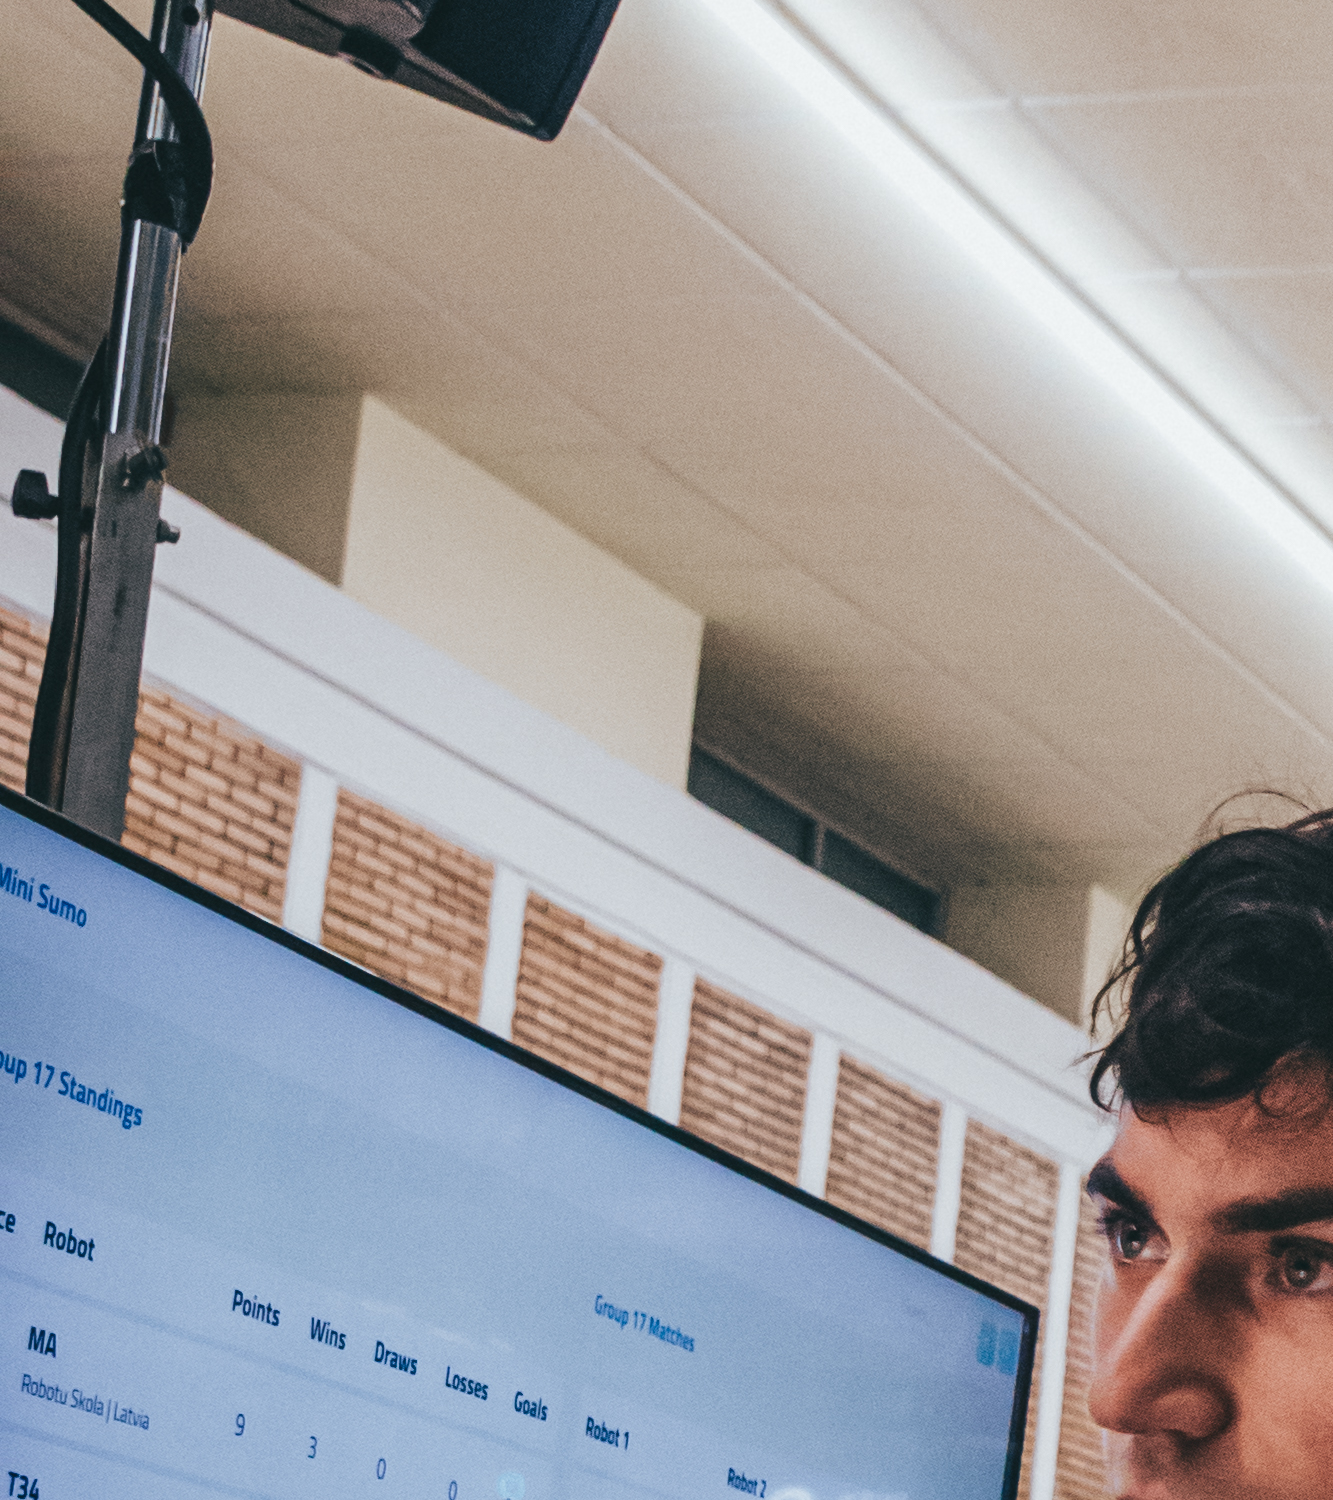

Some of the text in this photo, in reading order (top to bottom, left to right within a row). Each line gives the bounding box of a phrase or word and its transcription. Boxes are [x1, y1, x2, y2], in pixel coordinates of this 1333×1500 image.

[37, 884, 88, 928] Sumo
[34, 1061, 55, 1088] 17
[57, 1071, 143, 1129] Standings
[27, 1325, 57, 1358] MA
[43, 1221, 96, 1261] Robot
[232, 1289, 280, 1327] Points
[310, 1317, 346, 1350] Wins
[374, 1340, 418, 1375] Draws
[445, 1366, 488, 1400] Losses
[514, 1391, 548, 1421] Goals
[594, 1294, 696, 1352] Group 17 Matches
[21, 1373, 68, 1405] Robotu
[71, 1389, 105, 1418] Skola
[113, 1402, 150, 1430] Latvia
[234, 1413, 246, 1436] 9
[307, 1436, 318, 1458] 3
[376, 1458, 386, 1480] 0
[448, 1480, 458, 1500] 0
[586, 1416, 630, 1451] Robot 1
[727, 1467, 767, 1499] Robot 2
